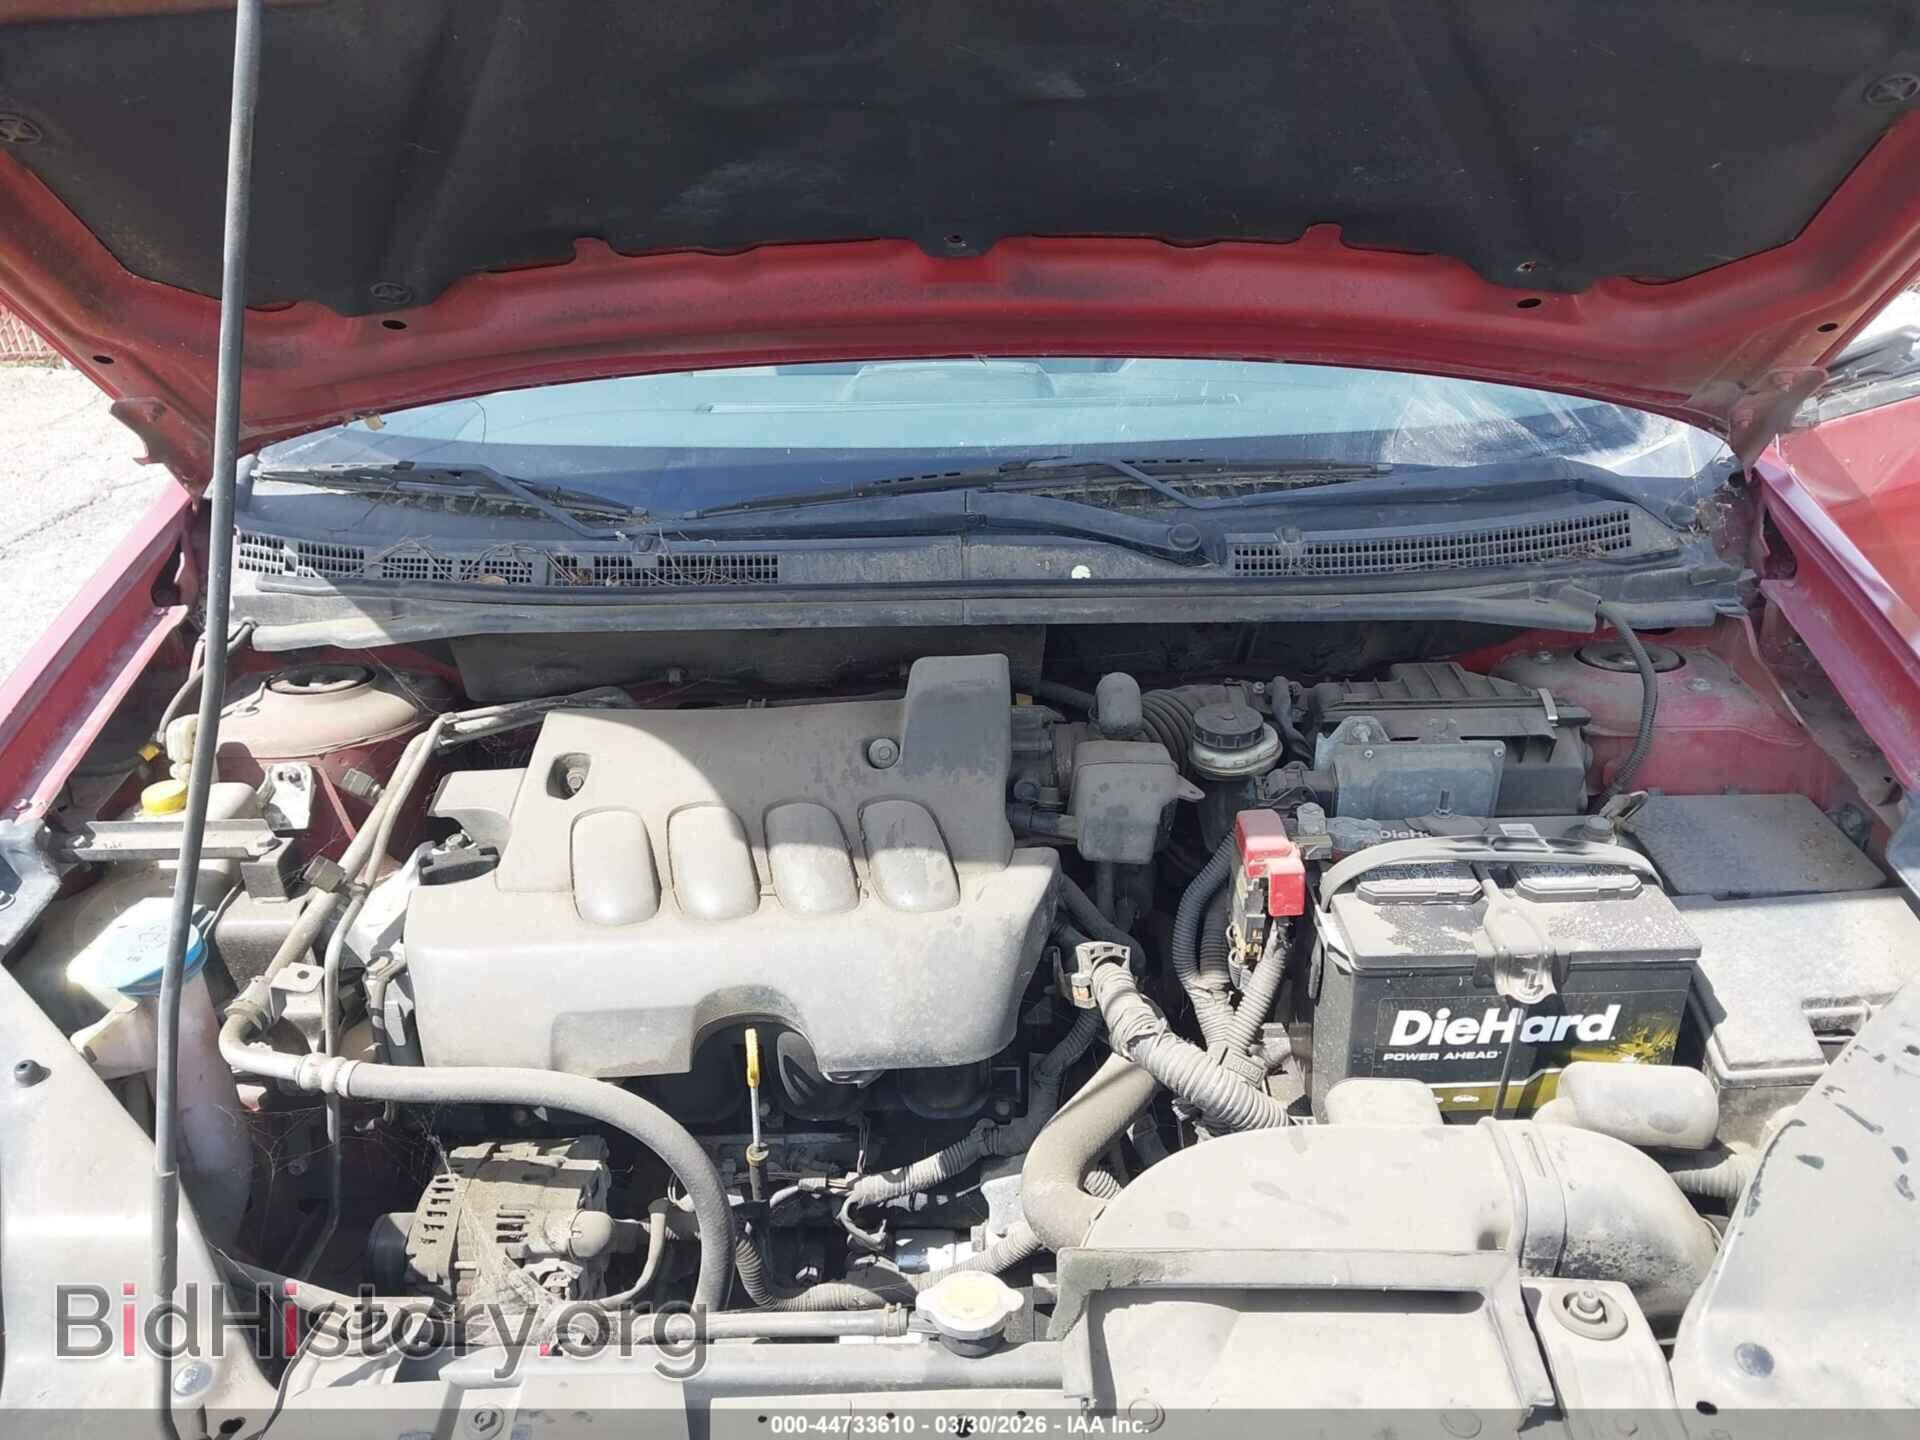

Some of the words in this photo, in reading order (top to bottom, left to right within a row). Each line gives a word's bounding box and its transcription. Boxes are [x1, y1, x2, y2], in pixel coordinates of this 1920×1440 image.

[1389, 1004, 1621, 1046] DieHard
[1383, 1052, 1439, 1061] POWER
[1443, 1050, 1499, 1060] AHEAD
